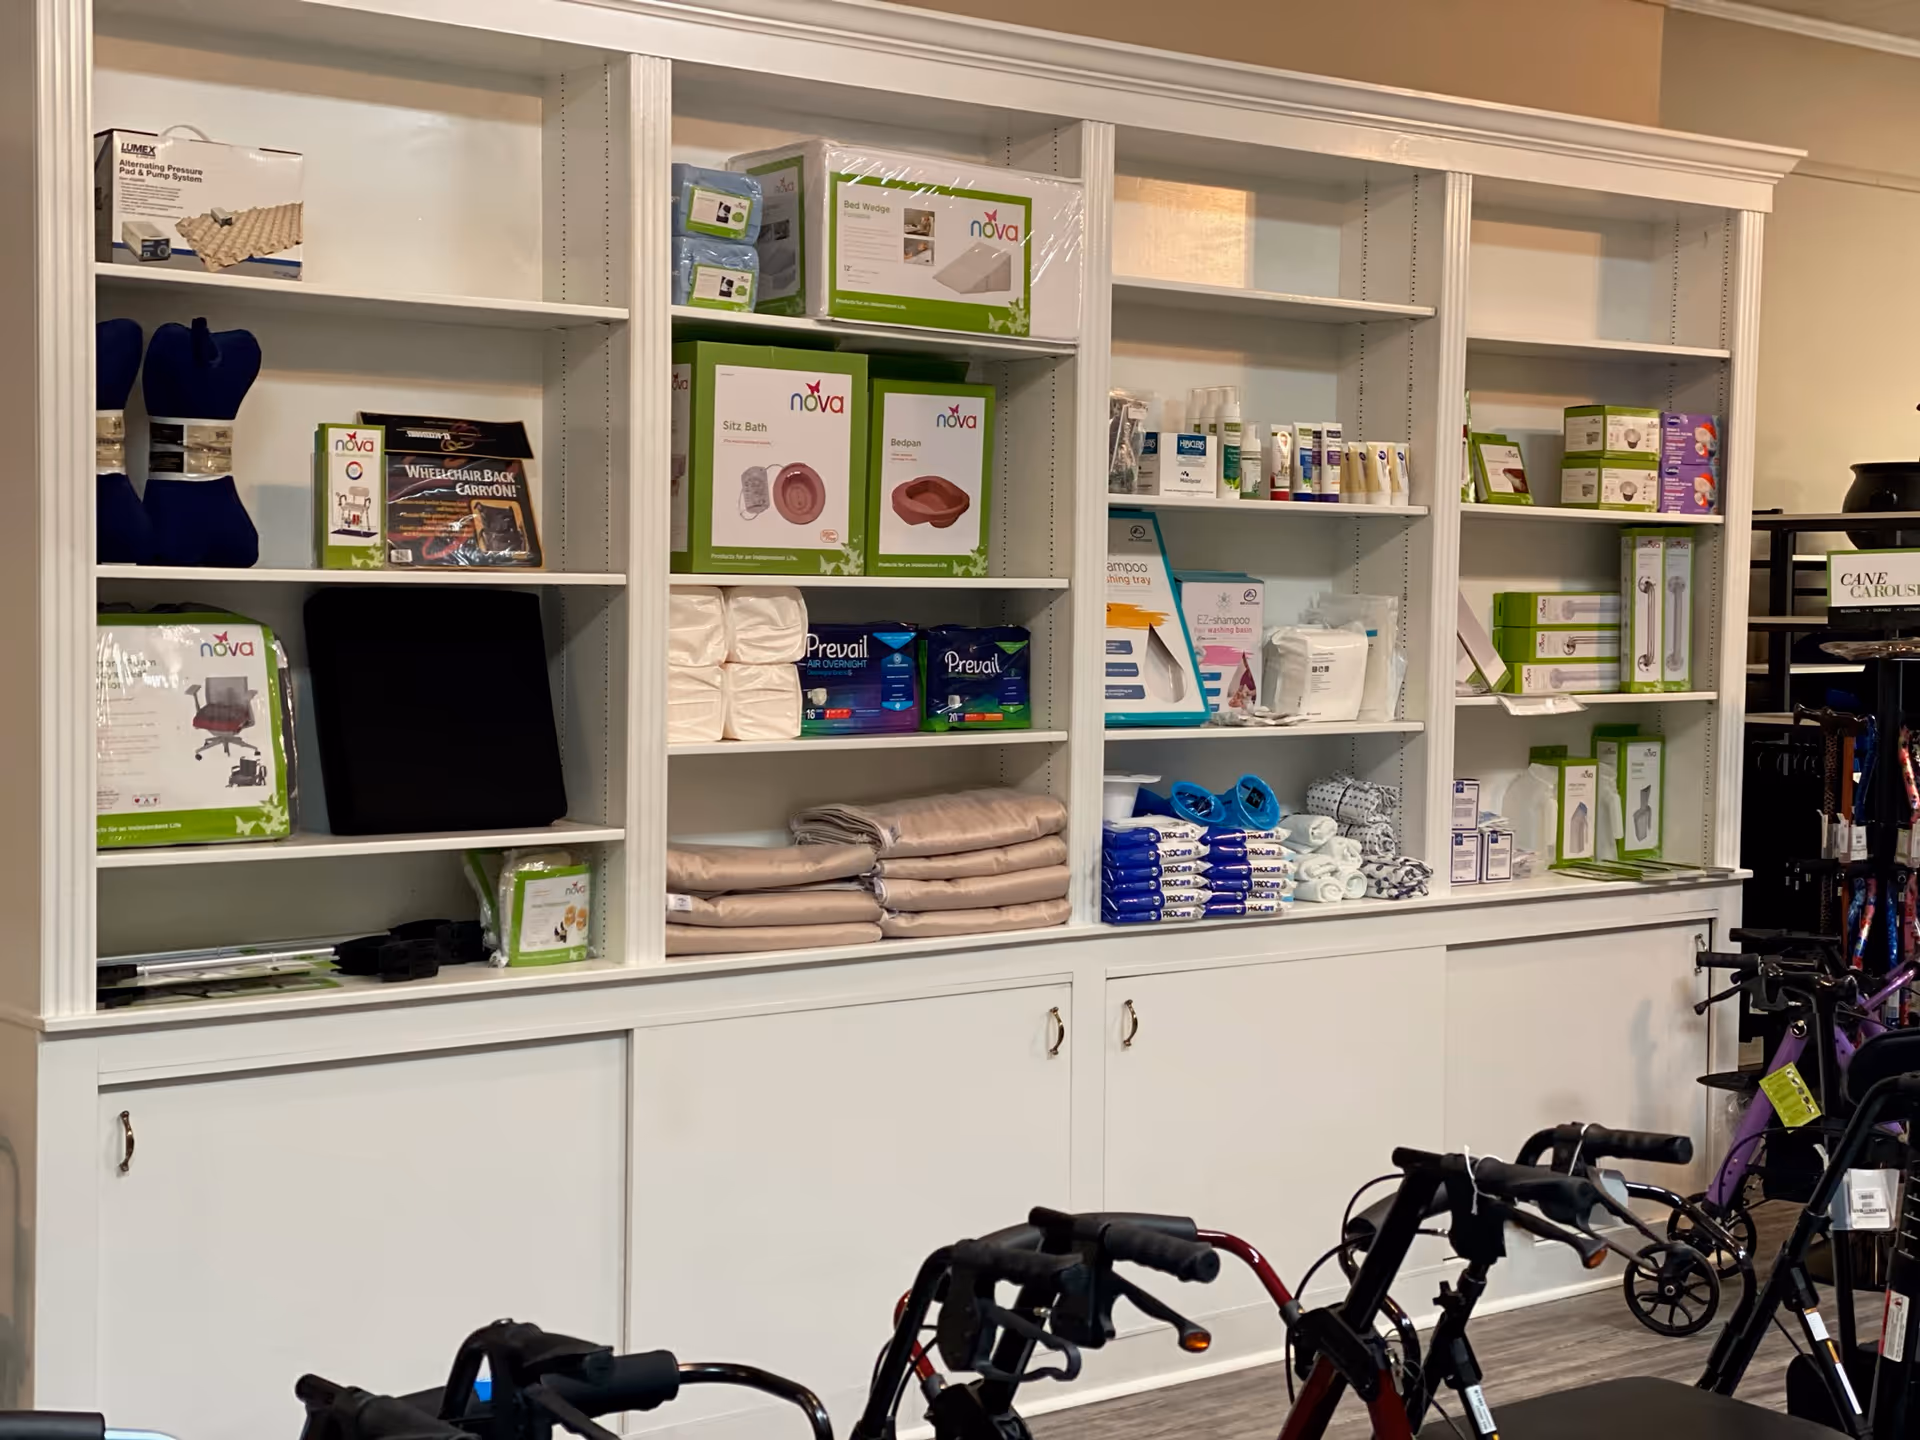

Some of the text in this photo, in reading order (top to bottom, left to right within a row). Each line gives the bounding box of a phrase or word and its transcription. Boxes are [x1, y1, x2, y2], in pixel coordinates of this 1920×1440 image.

[121, 143, 156, 155] LUMEX
[119, 160, 203, 176] Alternating Pressure
[119, 167, 136, 175] Pad
[146, 170, 170, 180] Pump
[172, 173, 203, 183] System
[843, 199, 891, 214] Bed Wedge
[970, 218, 1018, 242] nova
[790, 391, 844, 415] nova
[722, 420, 768, 432] Sitz Bath
[936, 413, 977, 430] nova
[335, 438, 374, 452] nova
[890, 438, 922, 448] Bedpan
[405, 465, 515, 483] WHEELCHAIR BACK
[456, 483, 517, 497] CARRYON!
[1132, 576, 1151, 585] tray
[1840, 572, 1888, 586] CANE
[1196, 614, 1250, 626] EZ-shampoo
[1207, 627, 1235, 635] washing
[200, 641, 254, 657] nova
[805, 632, 868, 658] Prevail
[807, 660, 867, 668] AIR OVERNIGHT
[944, 650, 1002, 674] Prevail
[806, 709, 816, 719] 16
[1161, 831, 1190, 839] PROCare
[1164, 865, 1192, 874] PROCare
[1162, 879, 1191, 887] PROCare
[1254, 880, 1280, 888] PROCare
[1166, 895, 1194, 904] PROCare
[1162, 910, 1191, 919] PROCare
